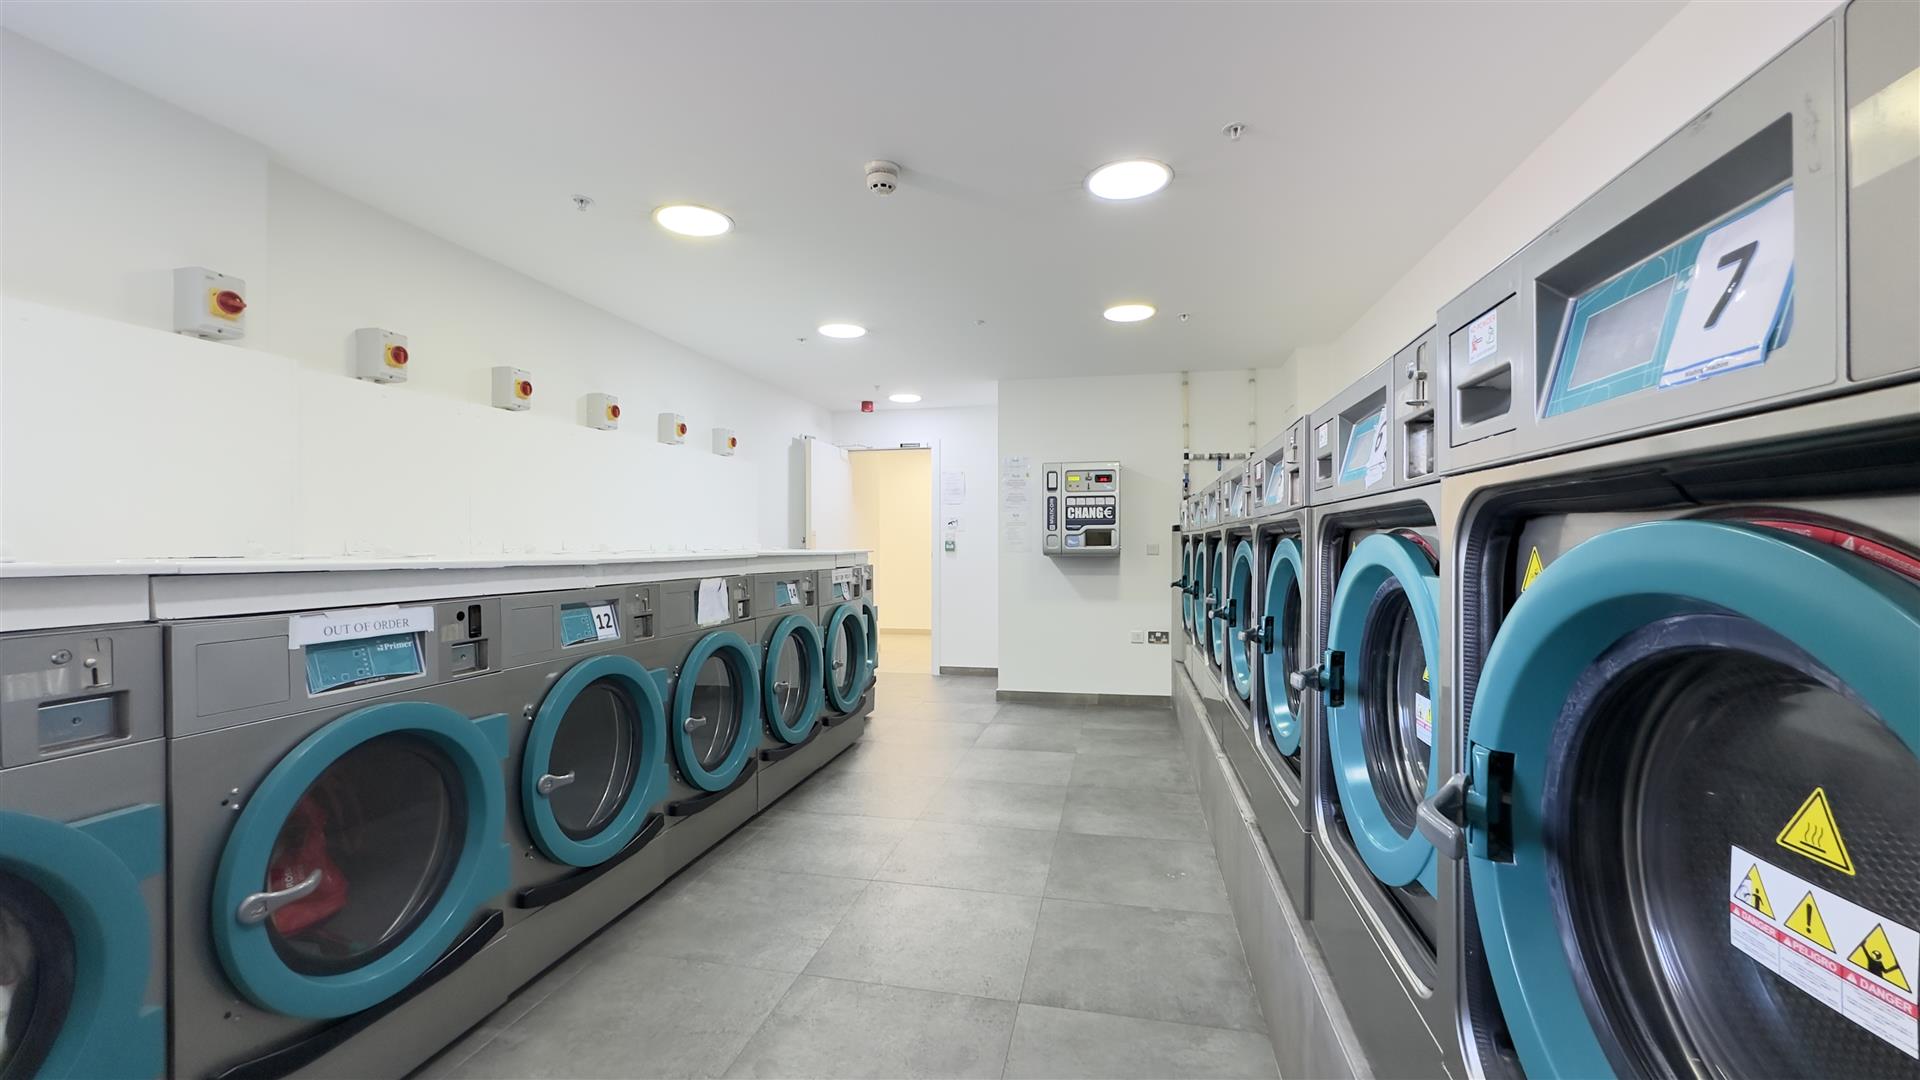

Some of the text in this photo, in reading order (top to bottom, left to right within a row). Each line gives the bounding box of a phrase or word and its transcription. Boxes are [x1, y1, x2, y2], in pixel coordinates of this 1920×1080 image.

[1703, 240, 1758, 329] 7
[323, 618, 410, 637] OUT OF ORDER
[596, 613, 613, 630] 12
[383, 640, 413, 651] Primer
[1741, 911, 1777, 937] DANGER
[1791, 942, 1838, 973] PELIGRO
[1859, 975, 1914, 1015] DANGER
